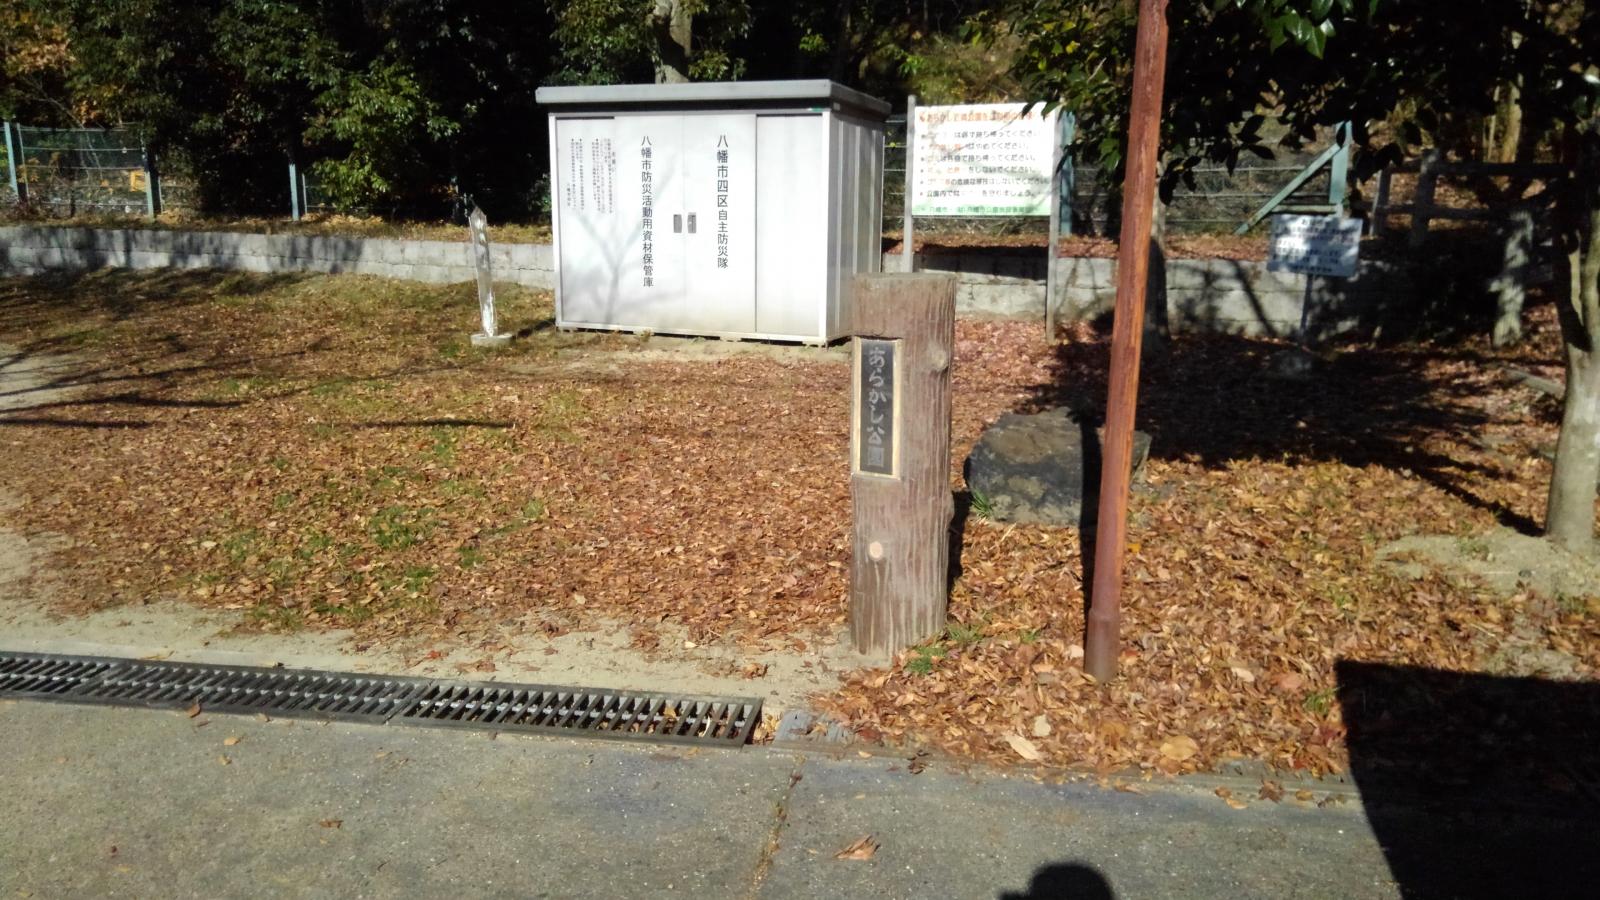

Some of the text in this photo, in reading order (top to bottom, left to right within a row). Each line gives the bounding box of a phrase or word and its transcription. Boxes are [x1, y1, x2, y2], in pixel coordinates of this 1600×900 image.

[641, 135, 654, 288] 八幡市防災活動用資材保管庫
[716, 134, 729, 269] 八幡市四区自主防災隊
[867, 346, 887, 468] あらかし公園
